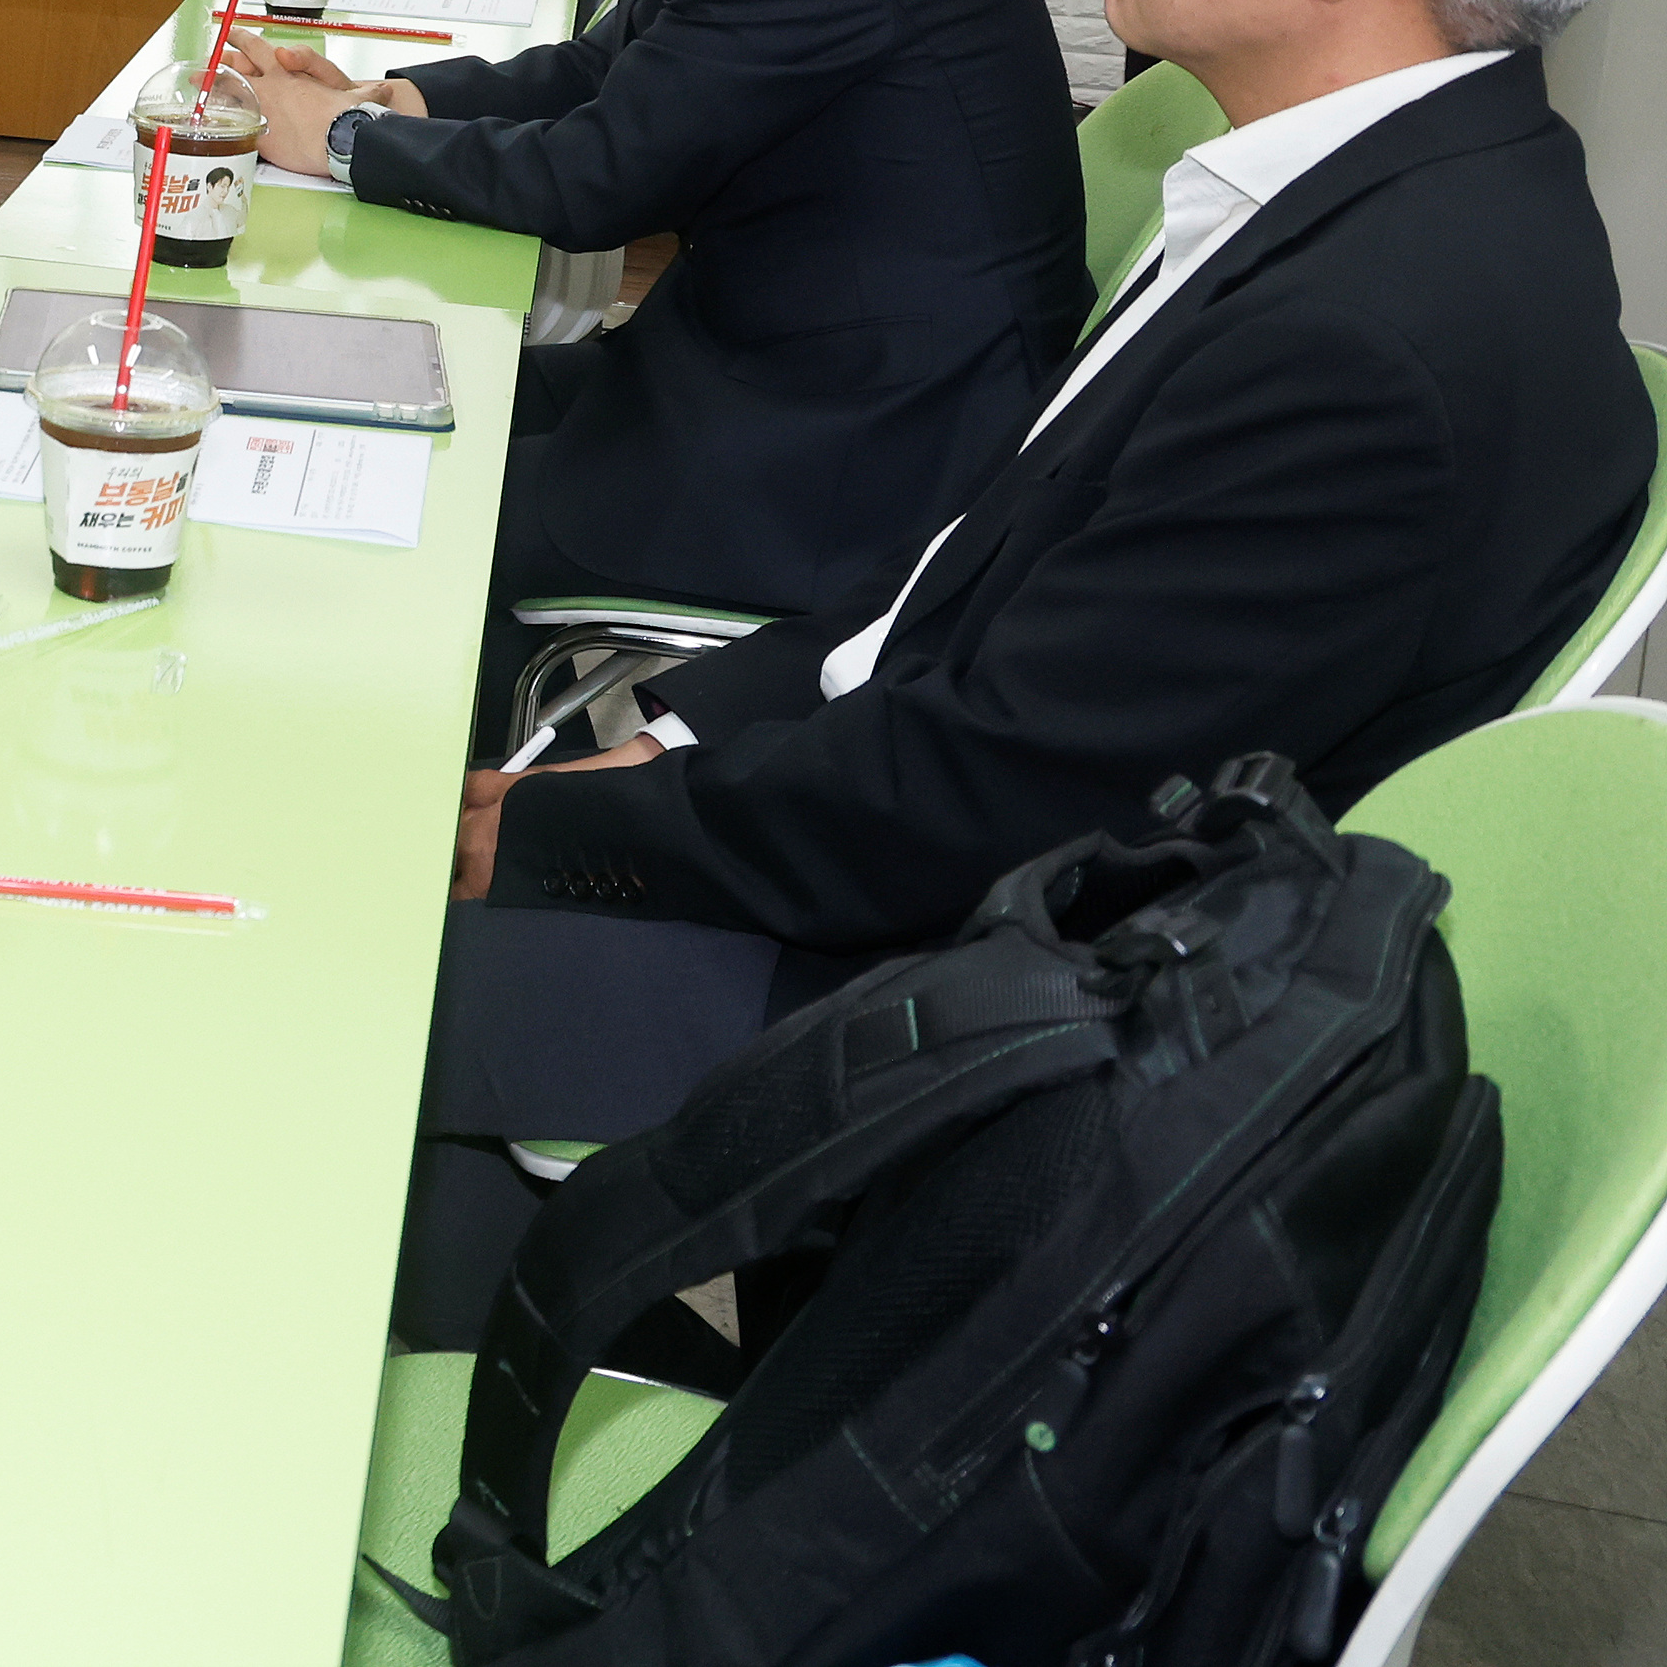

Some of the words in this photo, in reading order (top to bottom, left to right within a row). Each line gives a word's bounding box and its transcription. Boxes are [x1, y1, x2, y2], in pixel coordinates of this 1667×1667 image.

[272, 13, 312, 25] MAMMOTH
[313, 18, 343, 28] COFFEE
[79, 511, 136, 529] 채우는
[139, 492, 187, 532] 커피
[121, 545, 153, 553] COFFEE
